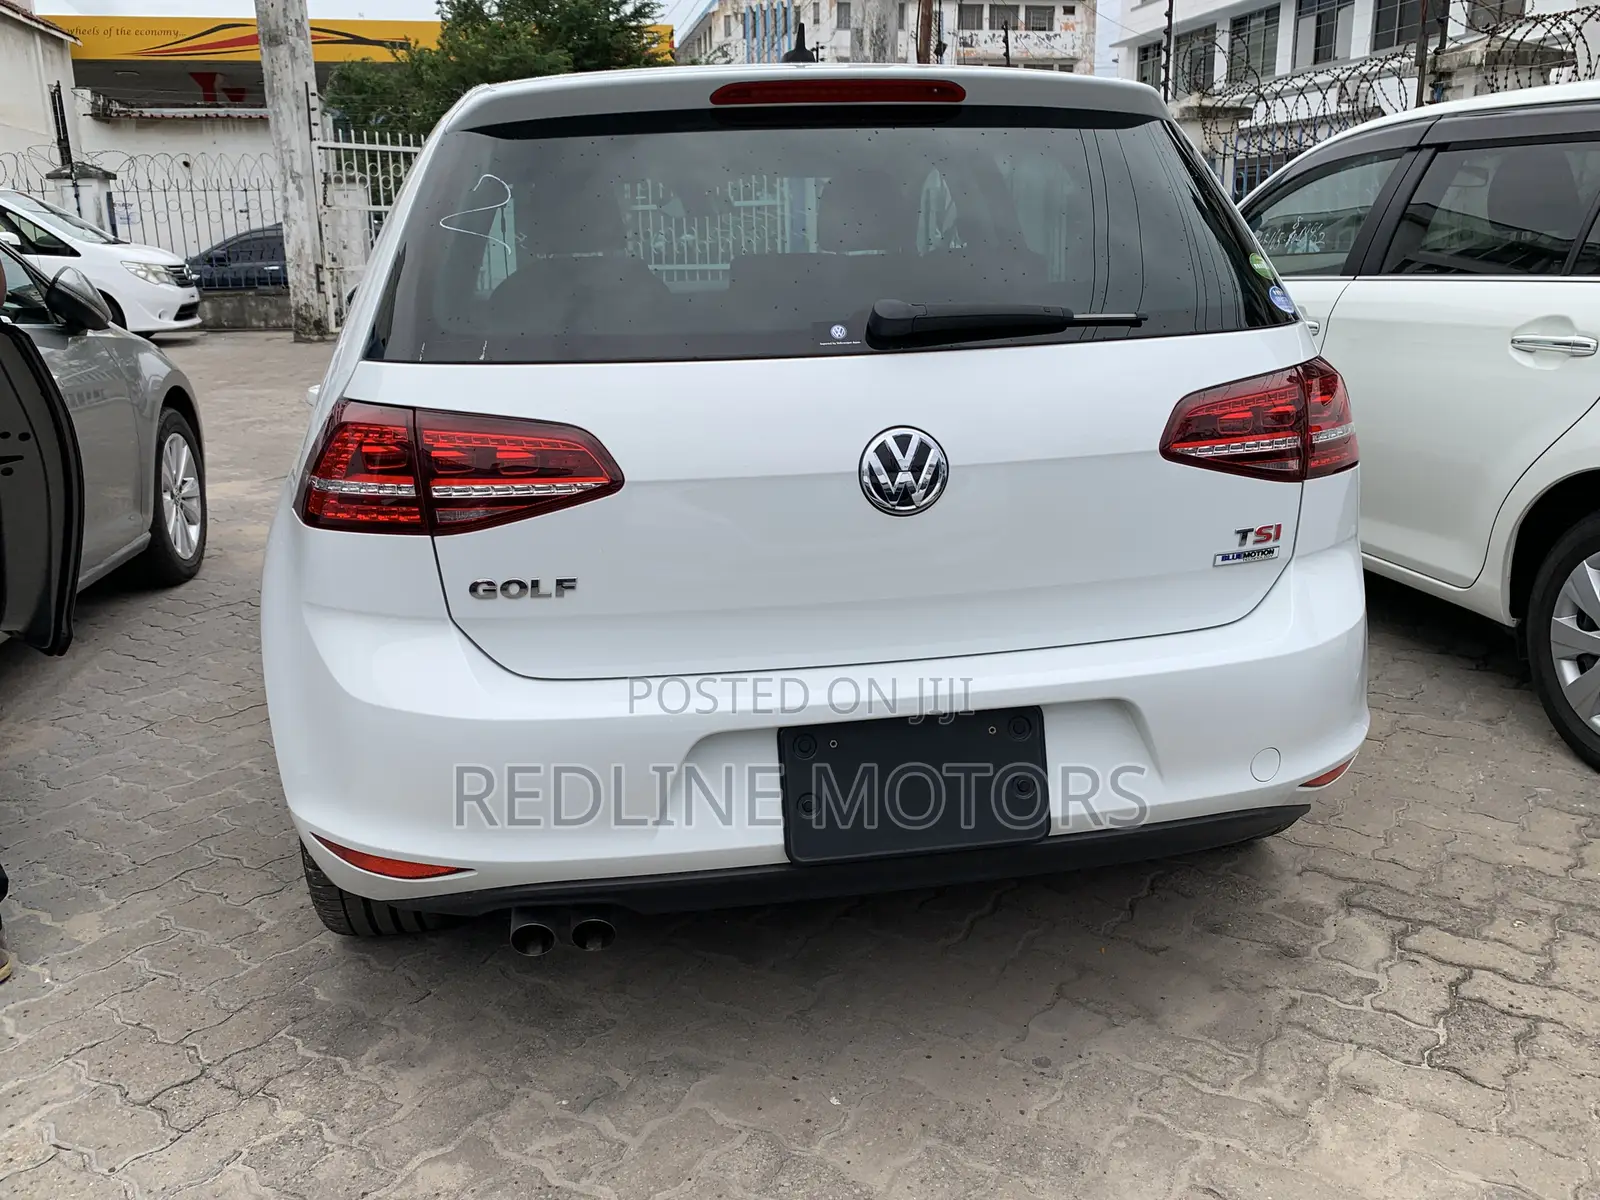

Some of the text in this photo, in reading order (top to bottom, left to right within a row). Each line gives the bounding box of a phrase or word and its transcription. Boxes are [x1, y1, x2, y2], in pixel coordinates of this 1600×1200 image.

[103, 26, 114, 37] of
[116, 26, 132, 36] the
[1235, 522, 1282, 547] TSI
[1221, 548, 1275, 562] BLUEMOTION
[468, 576, 578, 600] GOLF
